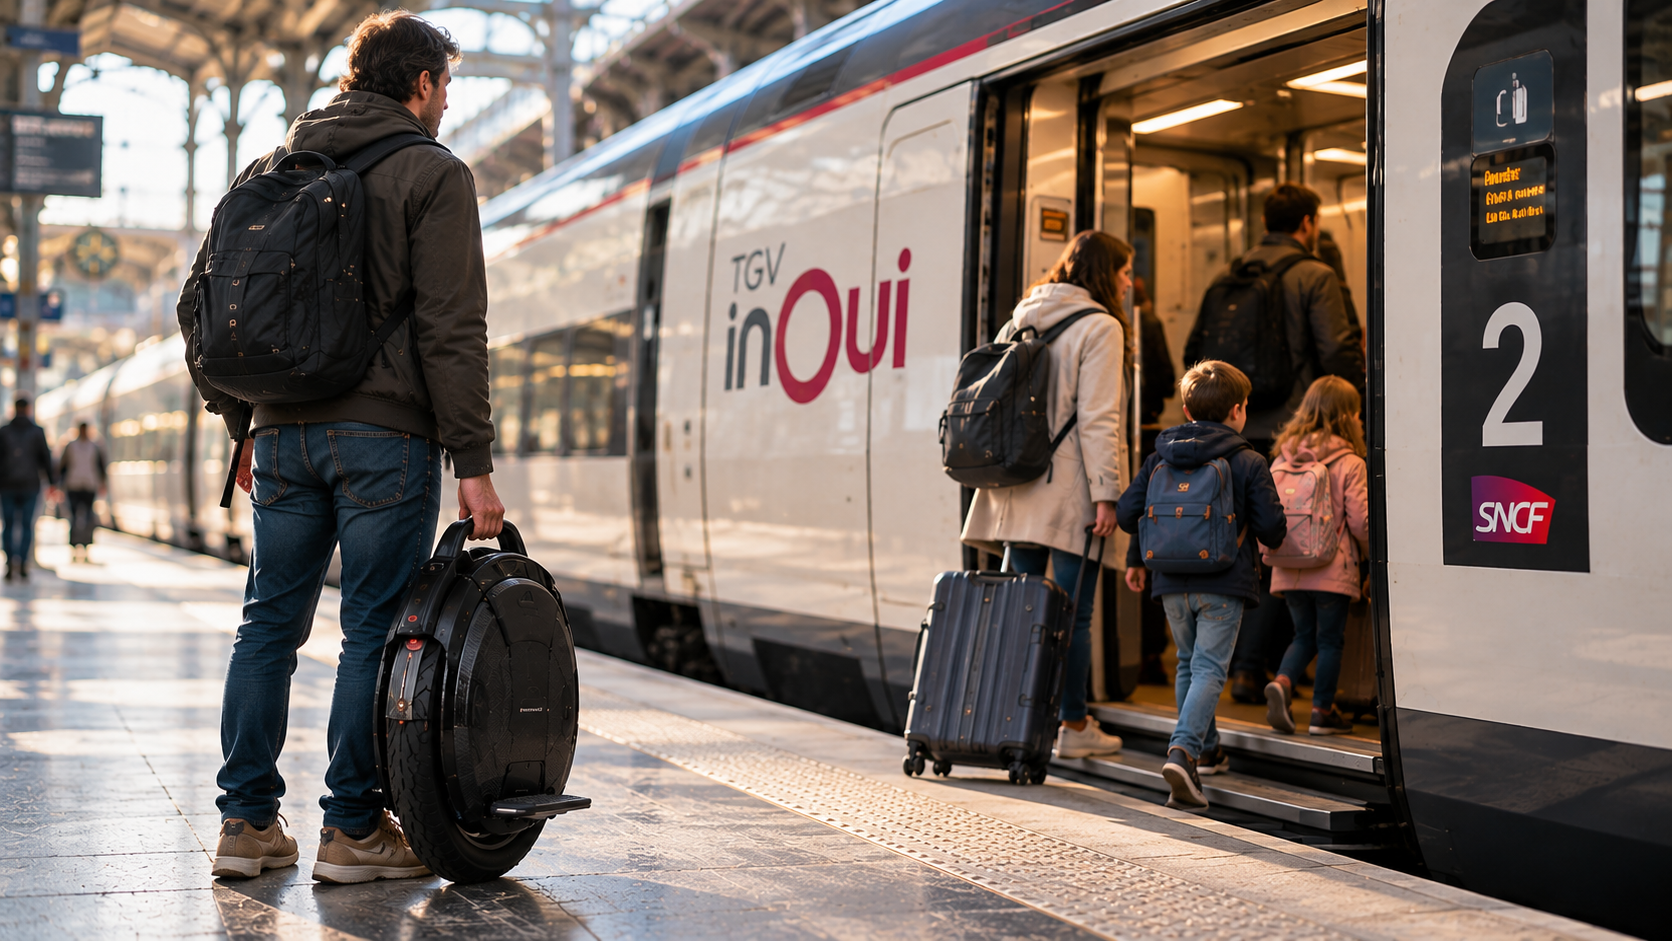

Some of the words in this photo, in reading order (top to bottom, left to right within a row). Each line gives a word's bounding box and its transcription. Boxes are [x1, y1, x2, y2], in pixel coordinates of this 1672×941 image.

[731, 241, 786, 294] TGV
[1482, 301, 1543, 447] 2
[1475, 501, 1549, 534] SNCF
